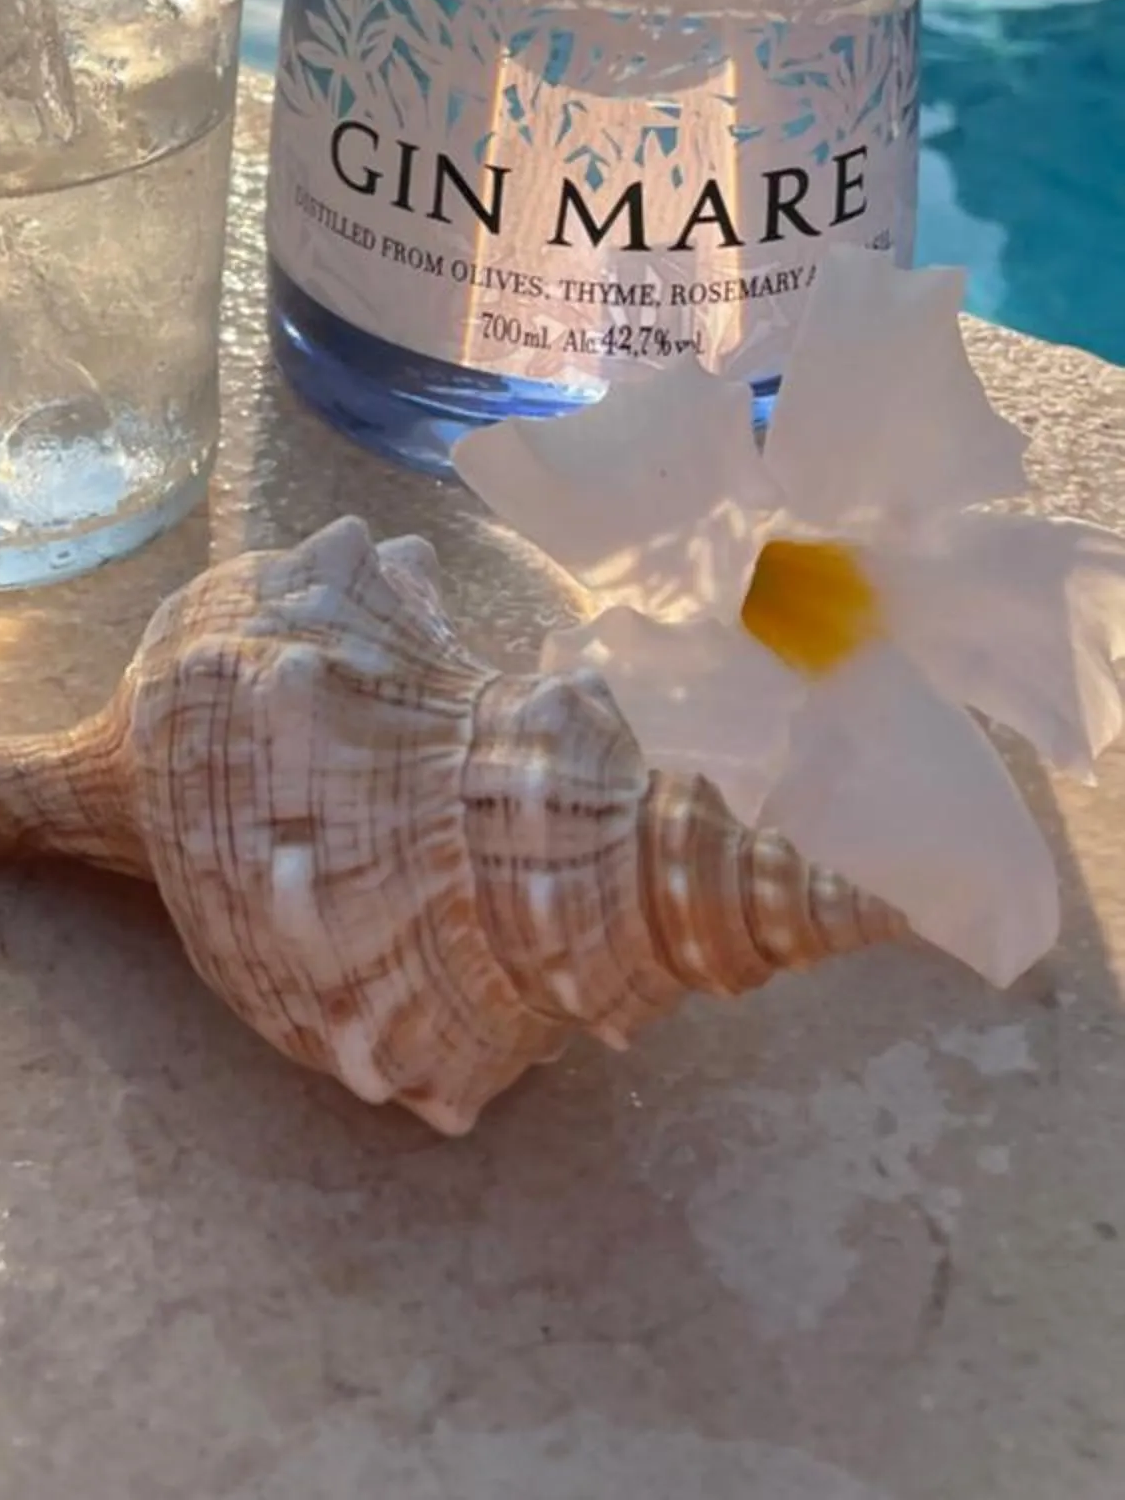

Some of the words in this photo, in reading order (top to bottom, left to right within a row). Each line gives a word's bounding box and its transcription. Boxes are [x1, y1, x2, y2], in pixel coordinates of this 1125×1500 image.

[294, 184, 376, 251] DISTILLED
[381, 236, 445, 278] FROM
[670, 267, 805, 306] ROSEMARY
[330, 121, 512, 235] GIN
[547, 145, 869, 253] MARE
